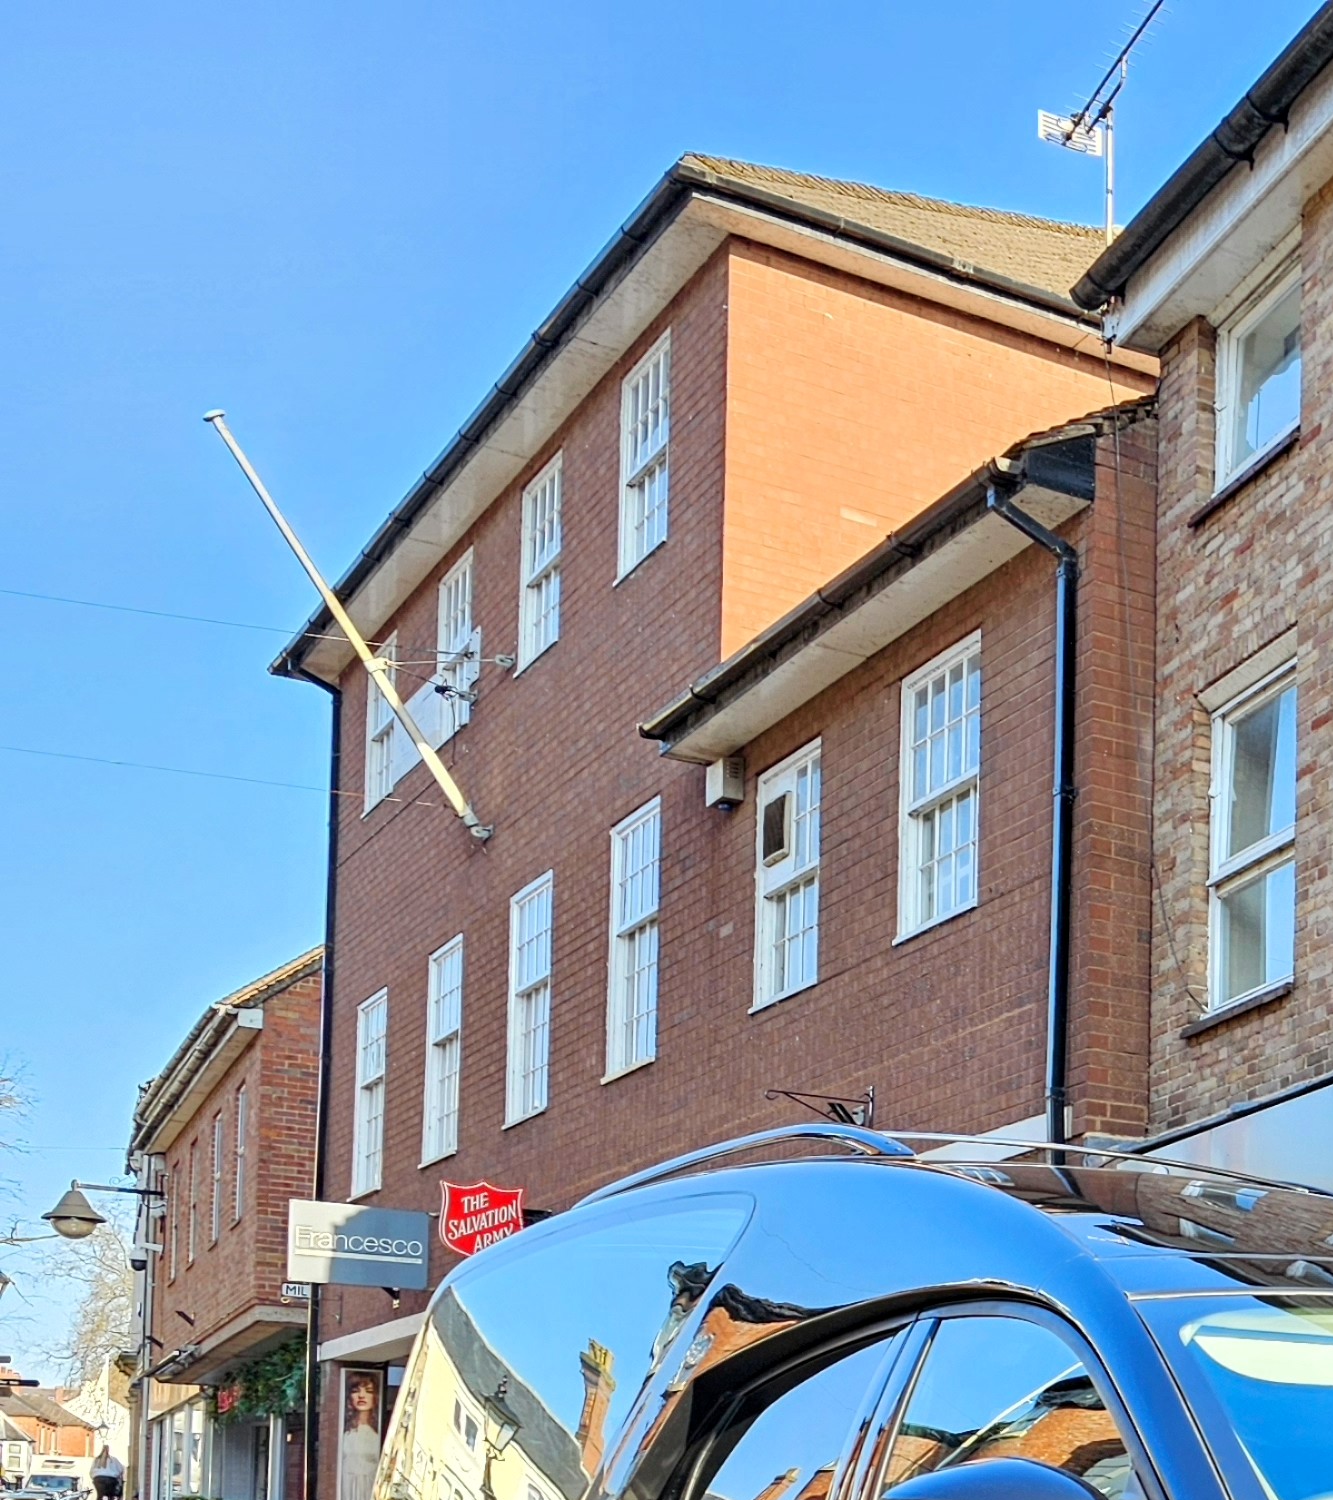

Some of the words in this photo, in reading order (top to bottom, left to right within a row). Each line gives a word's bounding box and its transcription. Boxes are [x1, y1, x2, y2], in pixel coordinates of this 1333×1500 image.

[461, 1192, 489, 1213] THE
[447, 1199, 517, 1240] SALVATION
[295, 1224, 423, 1256] Francesco
